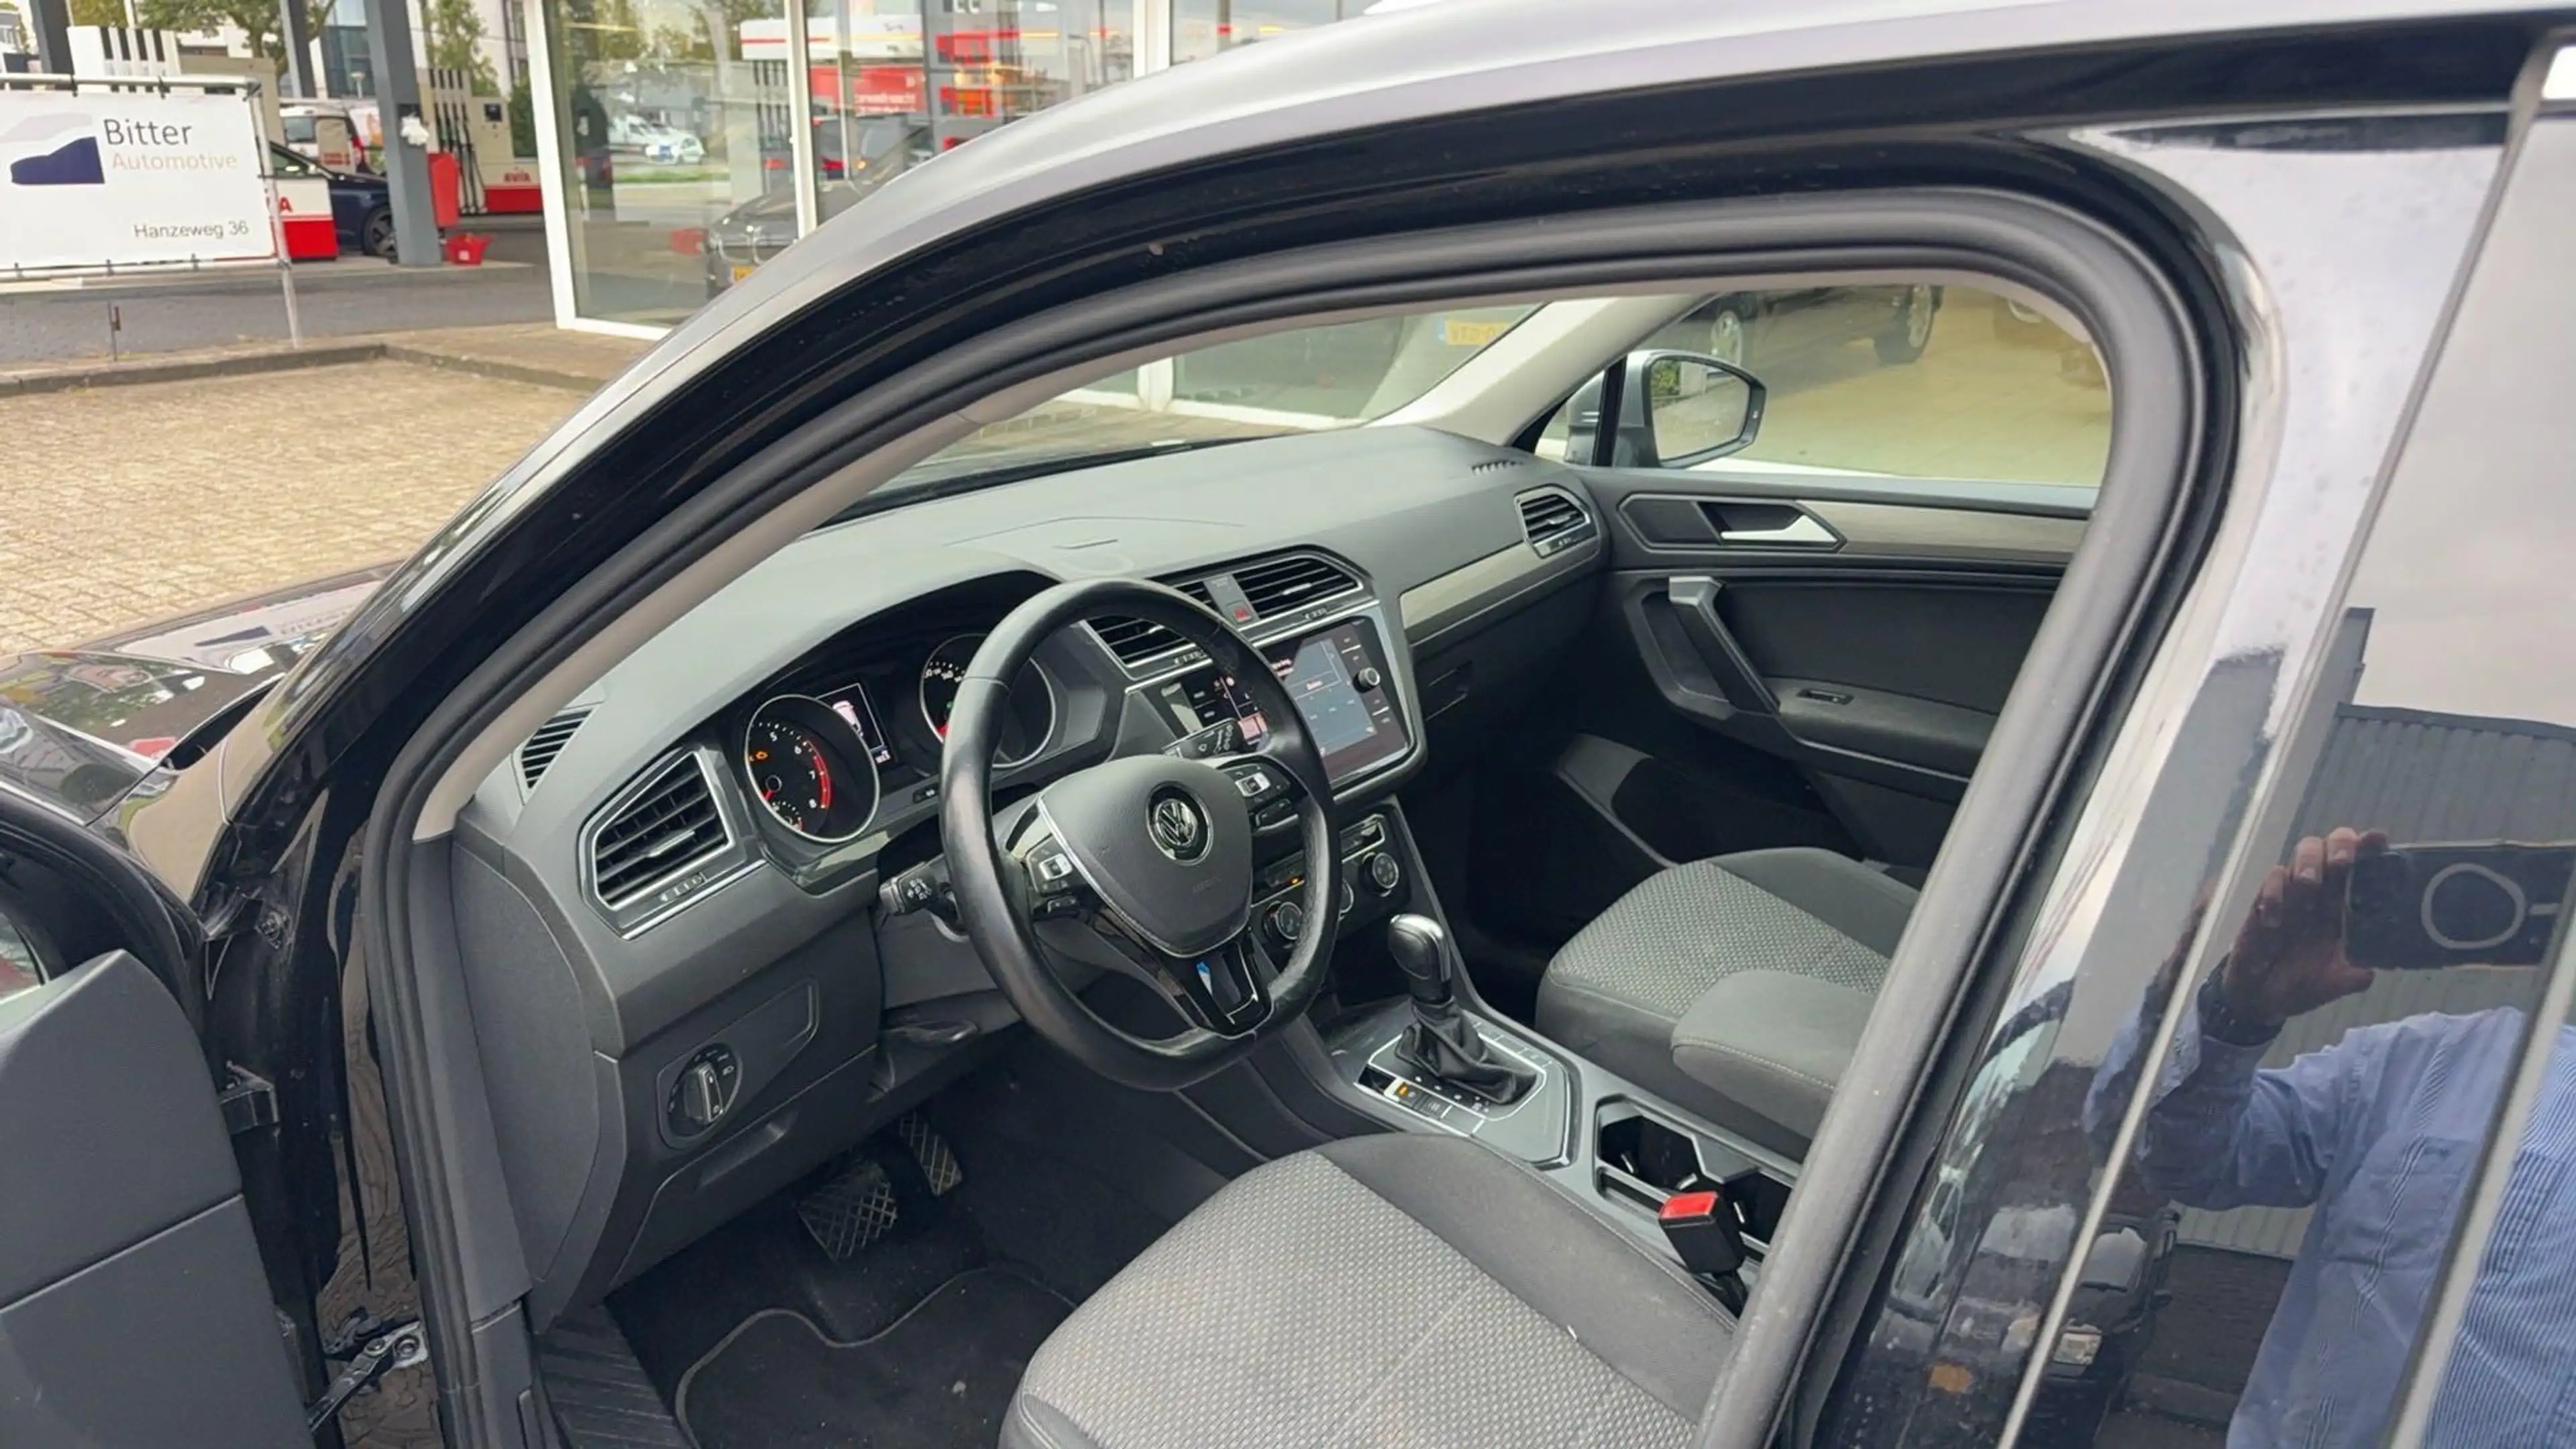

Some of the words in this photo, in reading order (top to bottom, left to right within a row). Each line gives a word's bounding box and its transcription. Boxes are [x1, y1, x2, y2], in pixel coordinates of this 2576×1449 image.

[103, 119, 193, 146] Bitter
[111, 153, 238, 170] Automotive
[133, 225, 224, 239] Hanzeweg
[229, 220, 249, 236] 36
